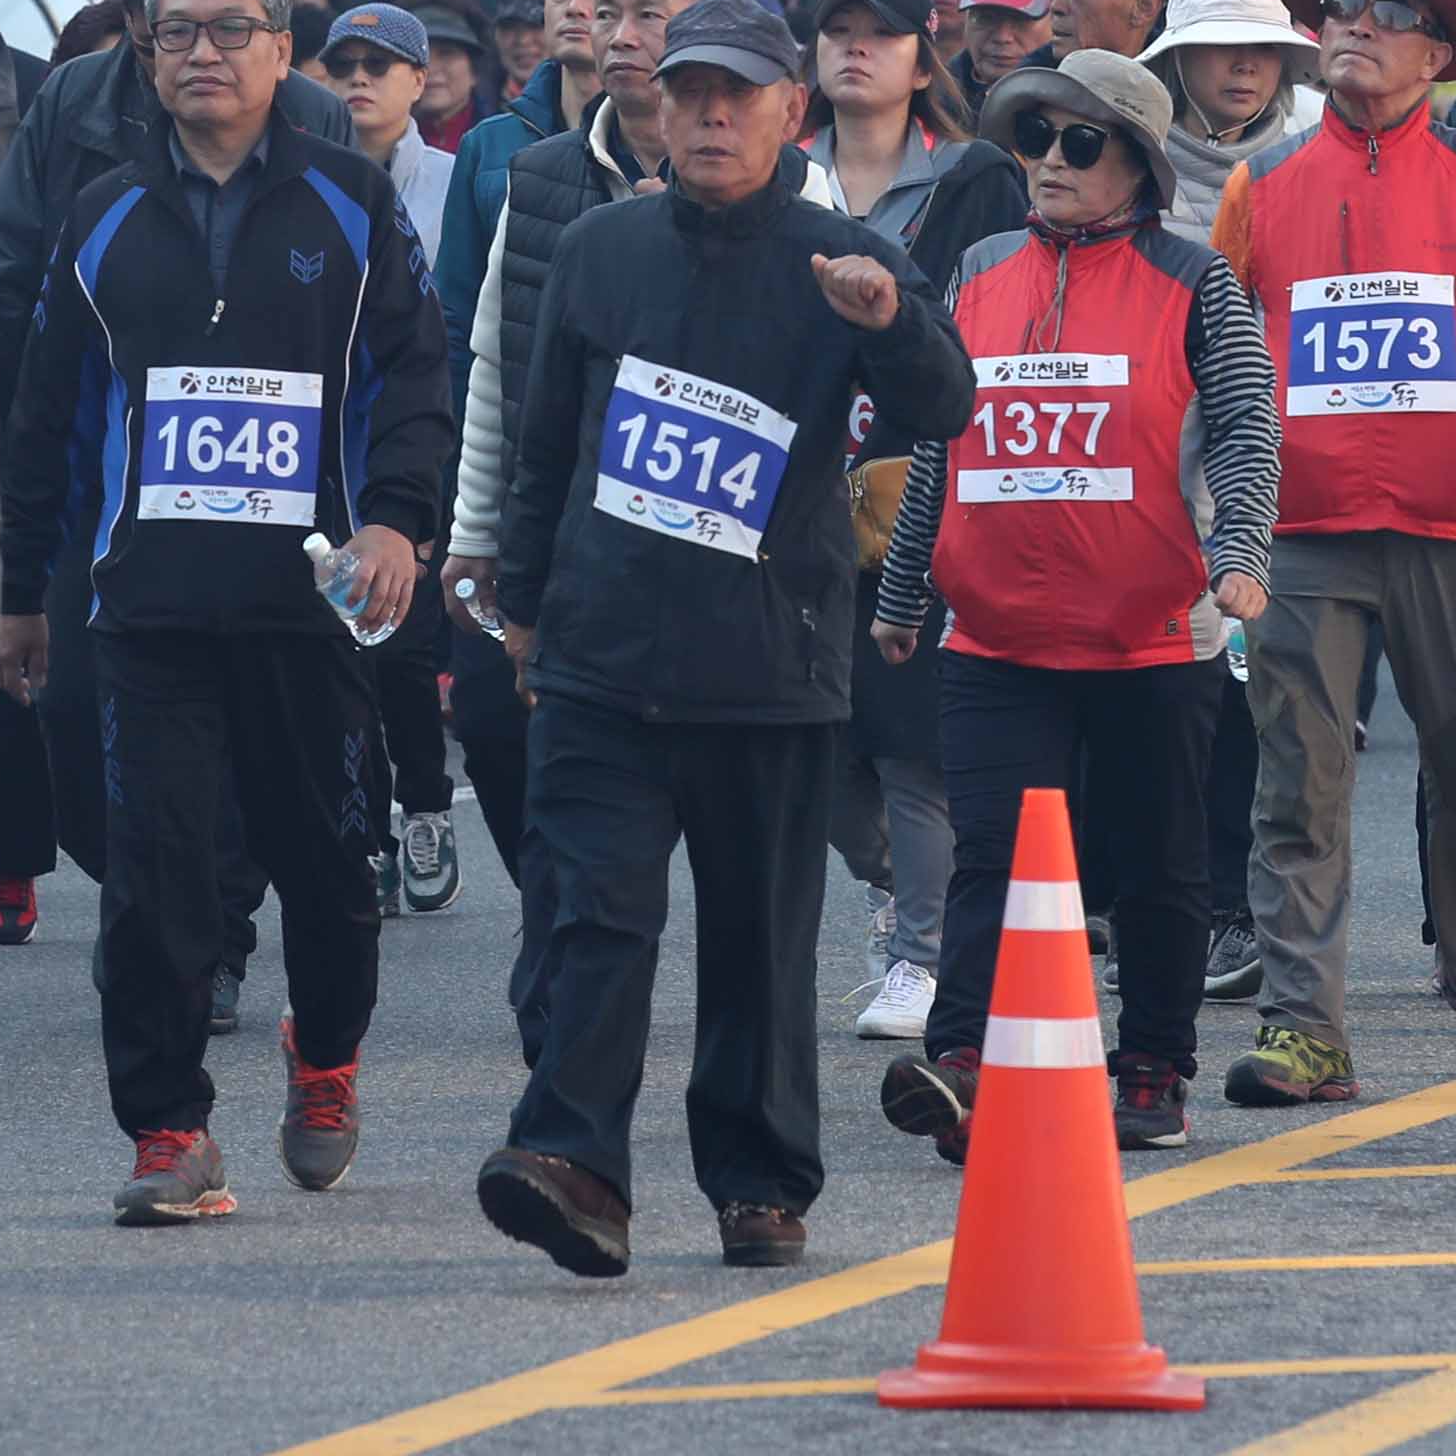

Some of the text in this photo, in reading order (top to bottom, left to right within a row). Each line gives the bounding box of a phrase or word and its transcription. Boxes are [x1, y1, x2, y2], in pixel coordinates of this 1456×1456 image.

[1349, 279, 1420, 299] 인천일보
[1303, 317, 1441, 373] 1573
[206, 375, 283, 397] 인천일보
[1018, 362, 1089, 380] 인천일보
[679, 382, 761, 425] 인천일보
[158, 415, 300, 478] 1648
[974, 401, 1111, 457] 1377
[617, 413, 762, 510] 1514
